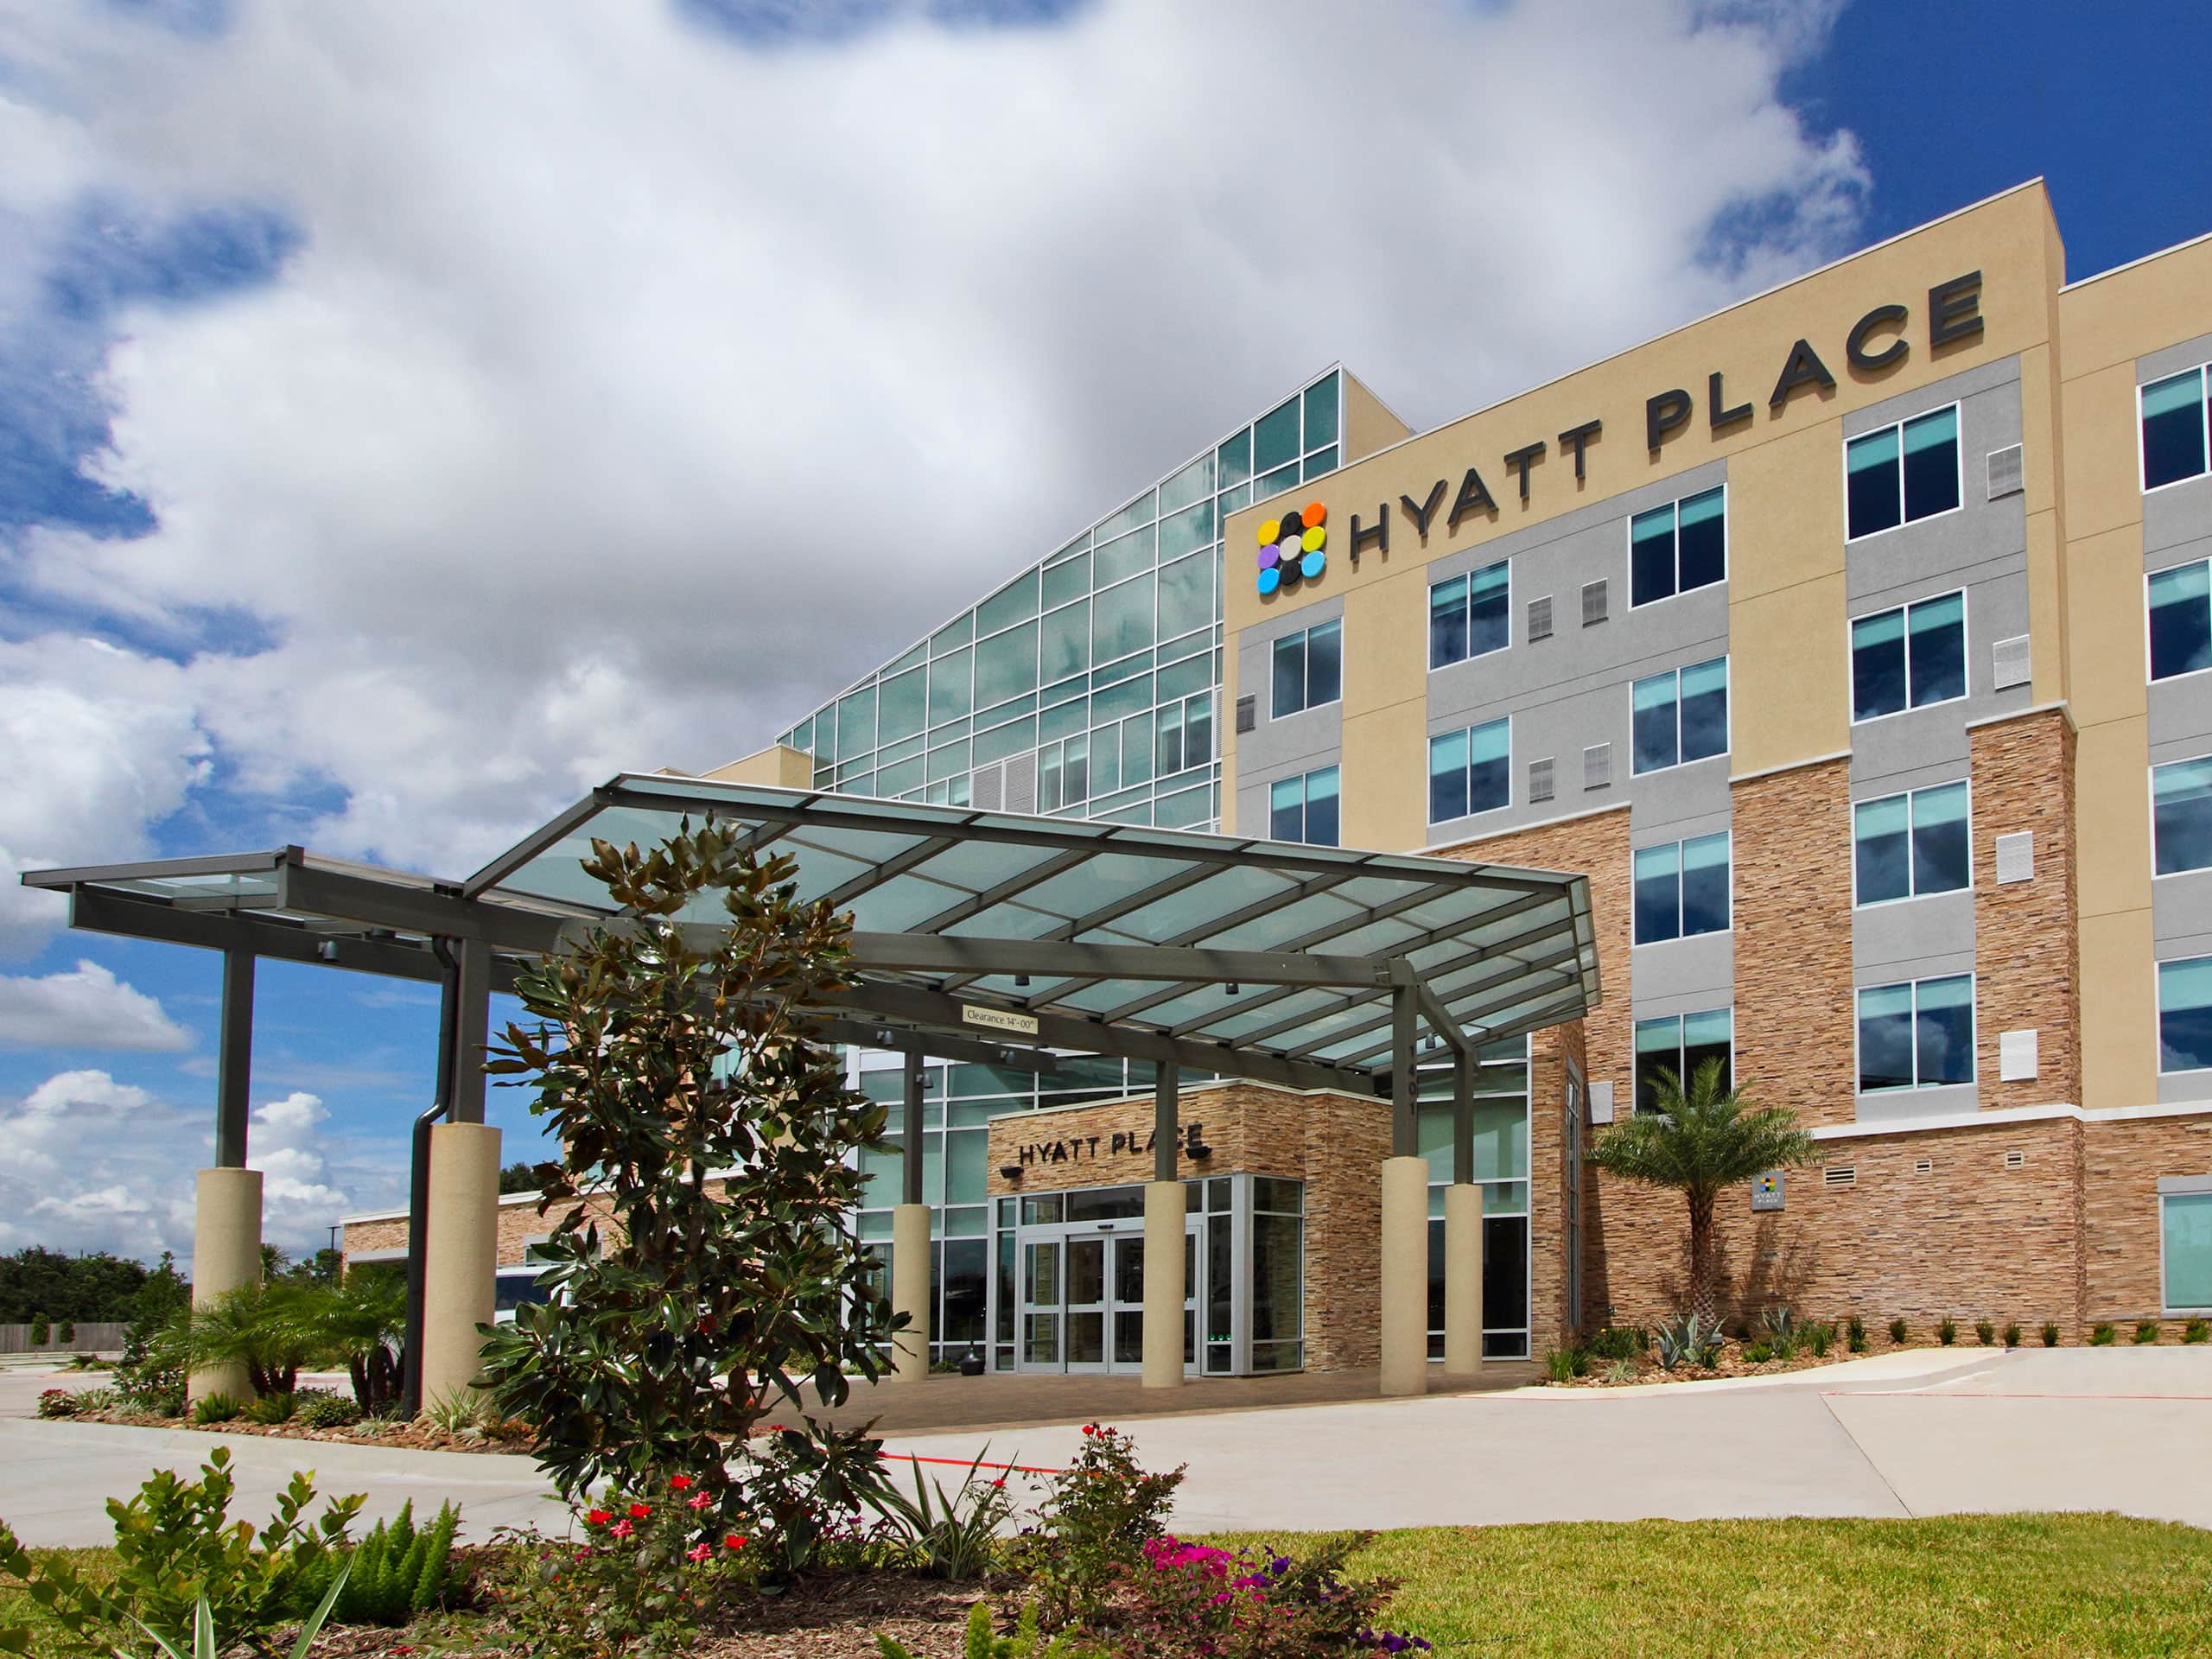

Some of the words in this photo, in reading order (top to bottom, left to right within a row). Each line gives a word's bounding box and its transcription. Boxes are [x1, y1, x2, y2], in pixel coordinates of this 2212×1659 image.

[1350, 420, 1602, 562] HYATT
[1646, 270, 1984, 452] PLACE
[967, 1009, 1004, 1024] Clearance
[1020, 1136, 1099, 1165] HYATT
